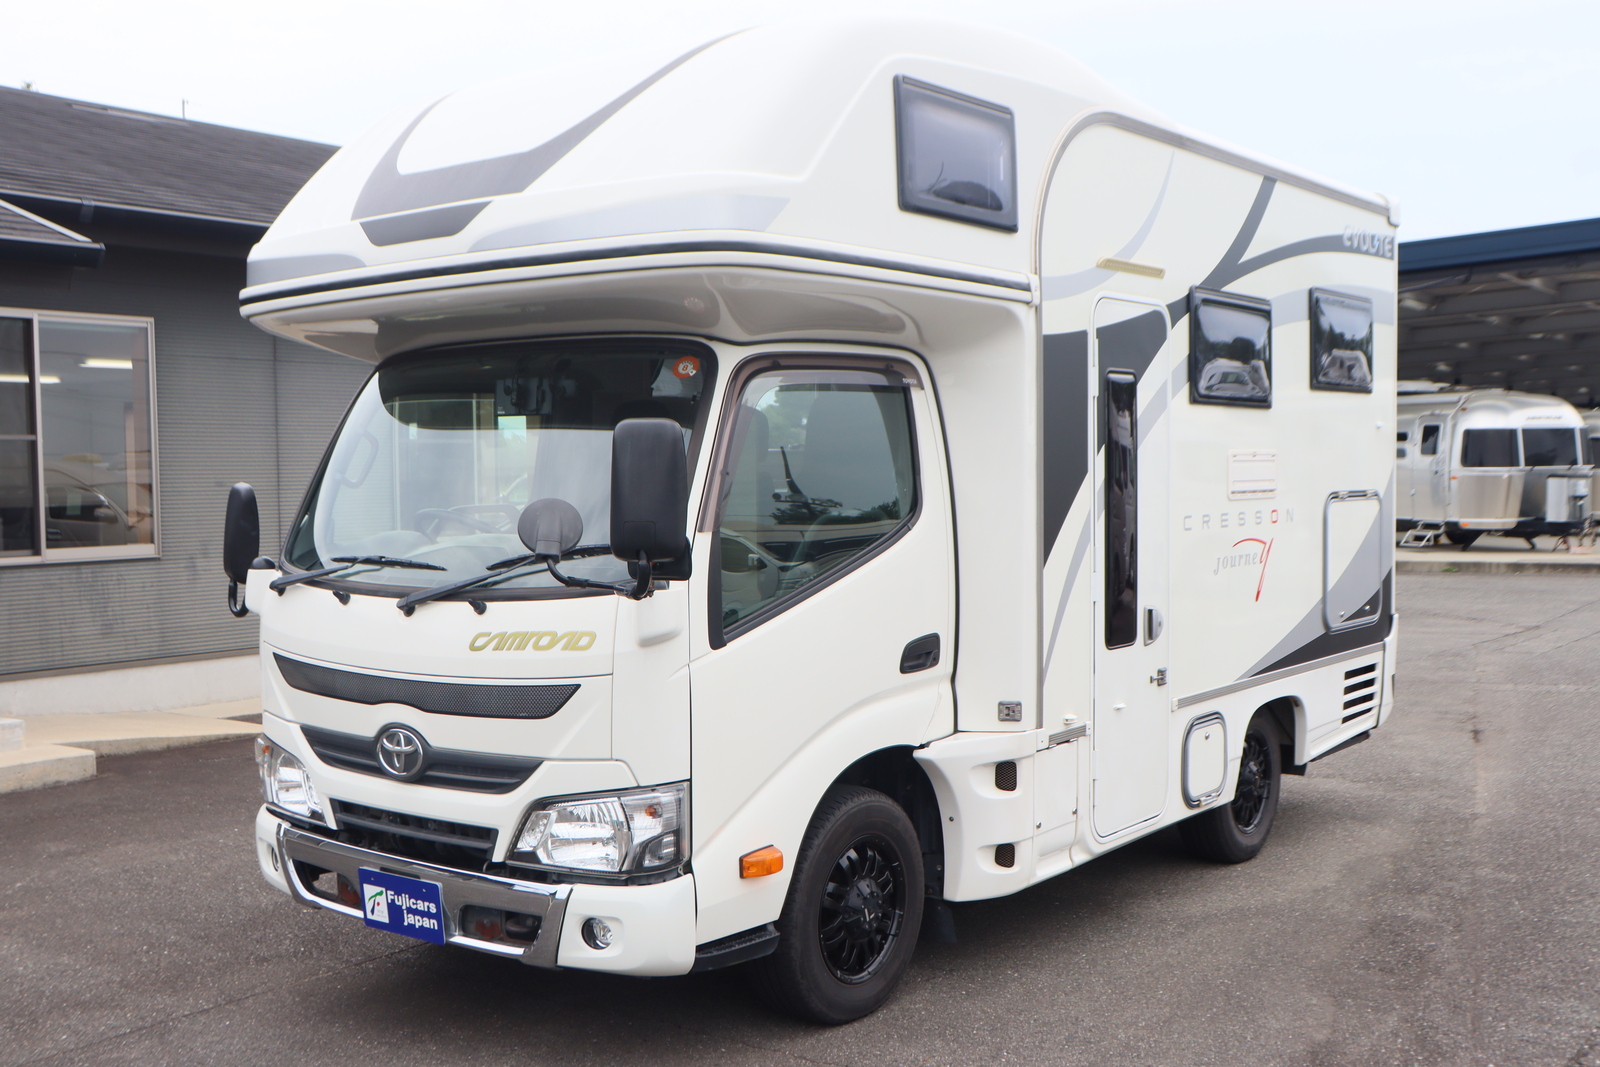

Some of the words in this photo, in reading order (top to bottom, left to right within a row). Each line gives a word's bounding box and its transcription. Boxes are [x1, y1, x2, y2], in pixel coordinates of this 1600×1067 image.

[1183, 508, 1295, 531] CRESSON
[387, 890, 437, 914] Fujicars
[403, 910, 438, 931] japan
